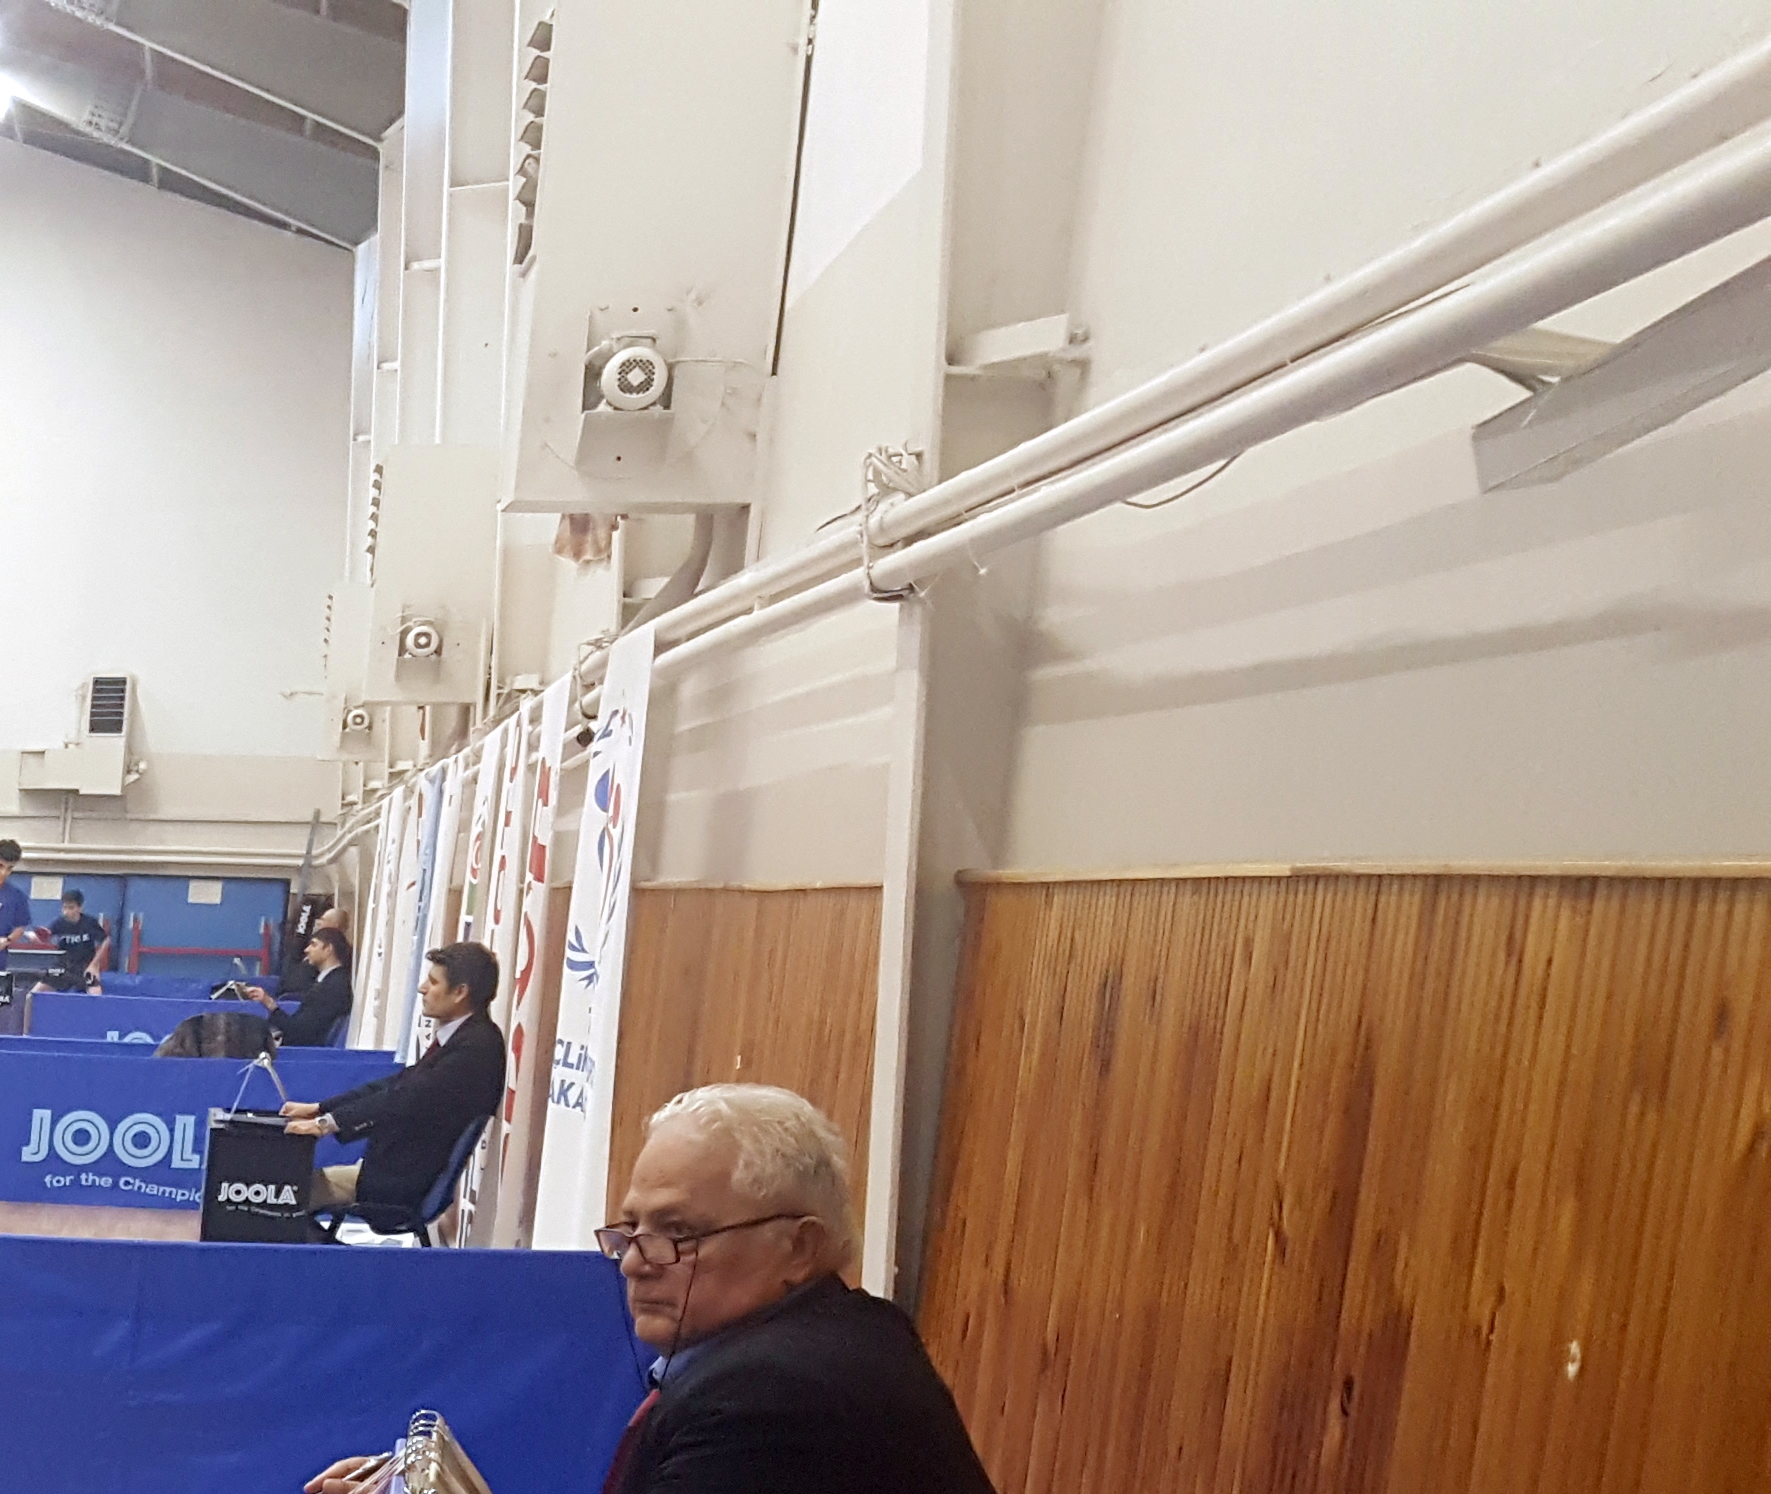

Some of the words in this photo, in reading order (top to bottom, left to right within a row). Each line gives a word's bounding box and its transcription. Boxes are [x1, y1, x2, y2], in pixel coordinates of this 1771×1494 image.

[21, 1108, 204, 1170] JOOL
[44, 1173, 73, 1188] for
[80, 1172, 113, 1187] the
[119, 1175, 204, 1203] Champio
[217, 1181, 297, 1206] JOOLA
